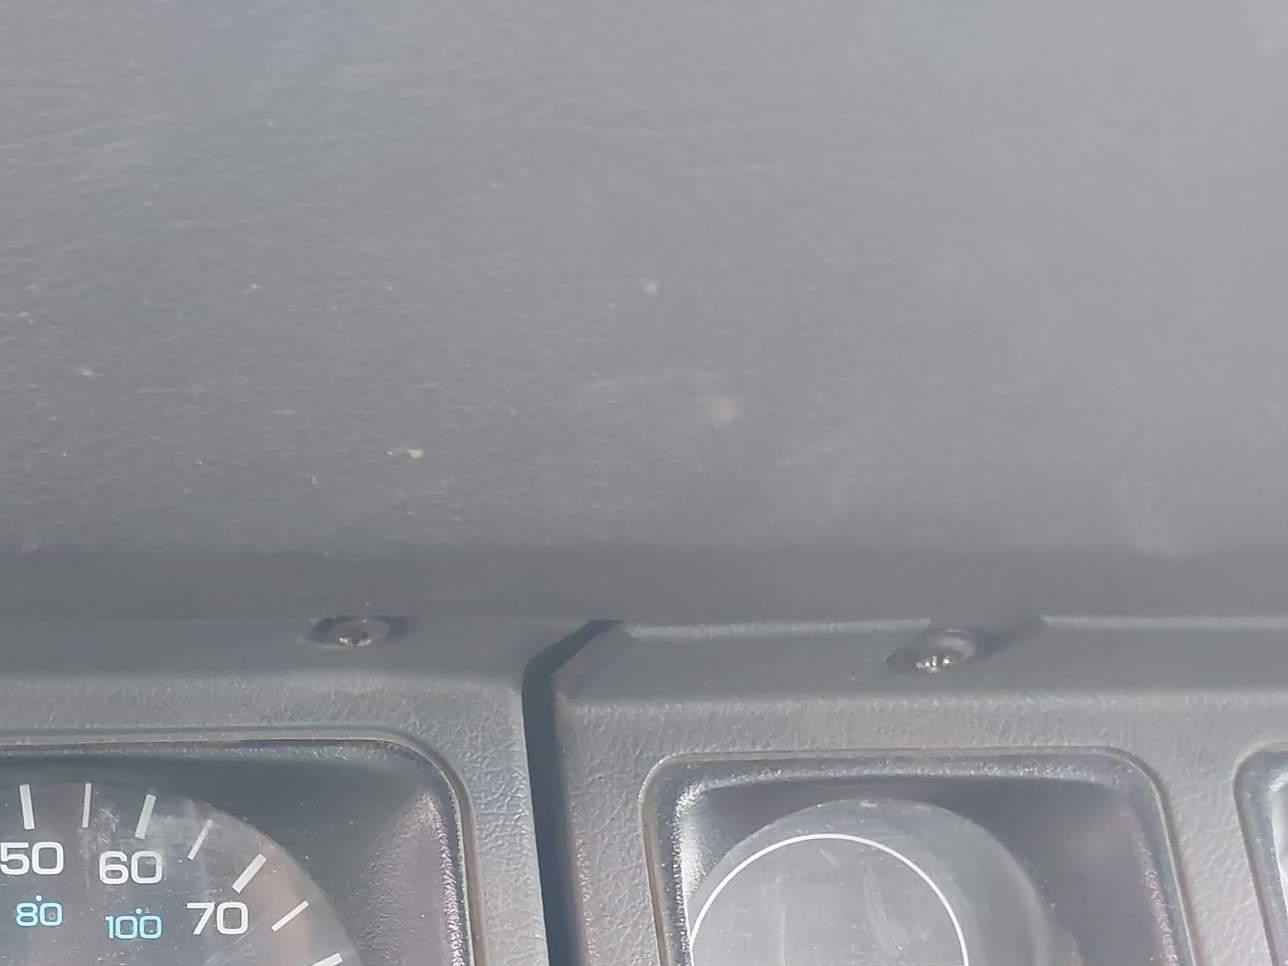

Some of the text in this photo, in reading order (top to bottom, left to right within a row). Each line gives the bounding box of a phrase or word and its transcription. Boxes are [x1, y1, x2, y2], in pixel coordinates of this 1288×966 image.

[0, 841, 64, 876] 50
[98, 850, 164, 885] 60
[15, 902, 63, 926] 80
[105, 915, 162, 940] 100
[186, 902, 249, 935] 70
